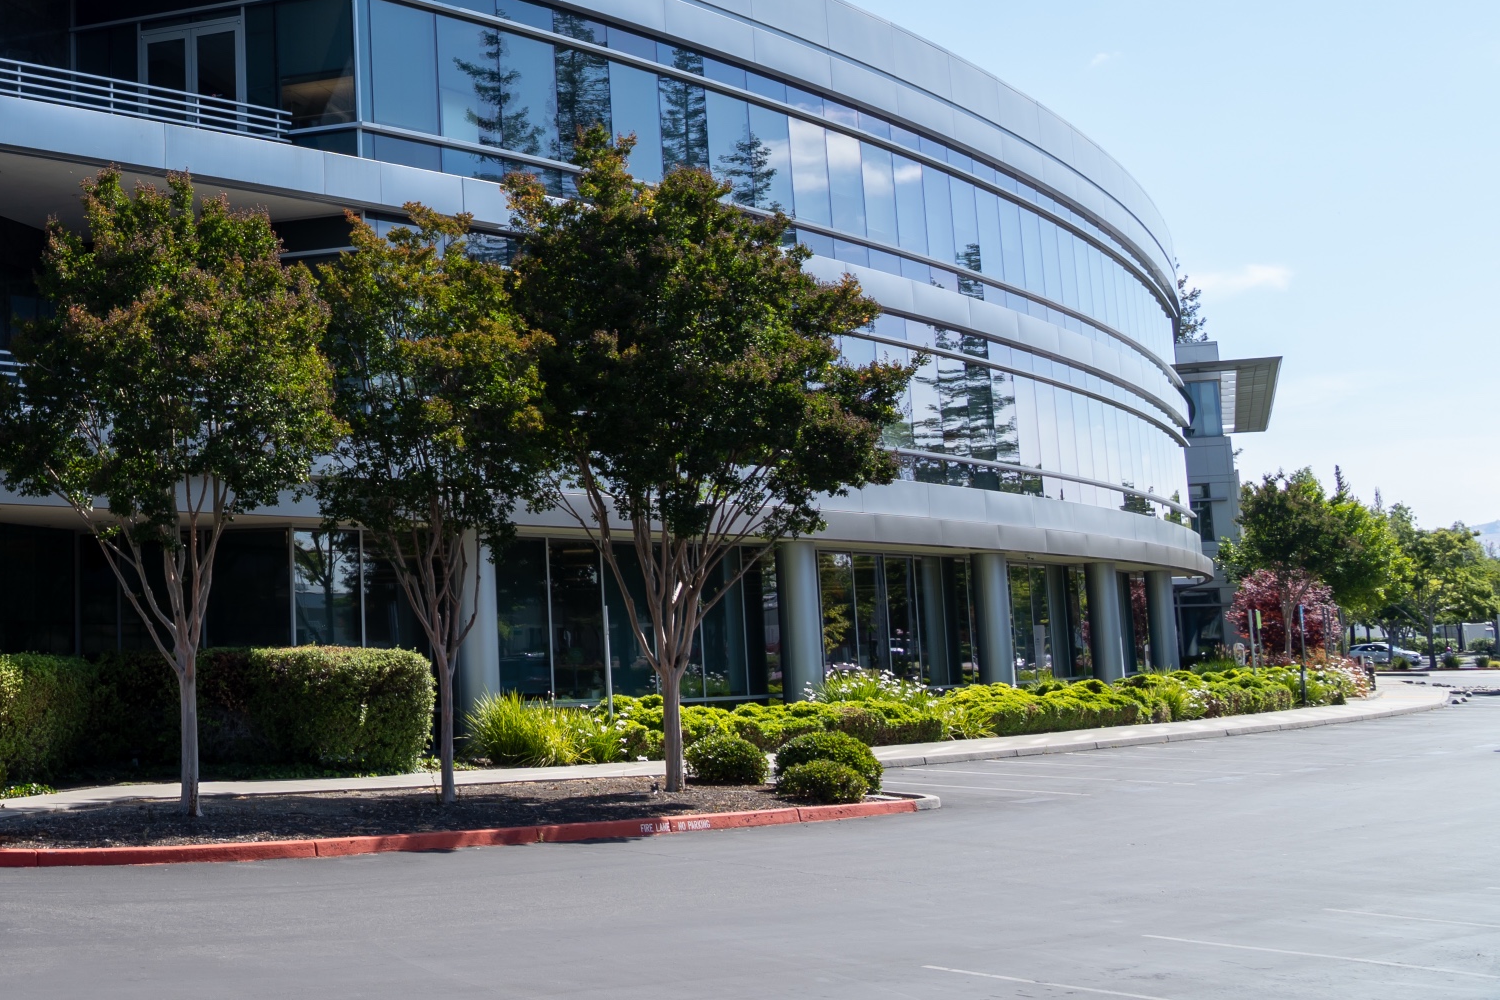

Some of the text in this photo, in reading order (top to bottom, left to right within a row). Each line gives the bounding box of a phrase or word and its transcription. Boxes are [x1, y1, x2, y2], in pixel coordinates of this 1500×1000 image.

[640, 823, 654, 833] FIRE
[655, 822, 671, 832] LANE
[677, 821, 687, 831] NO
[687, 819, 711, 830] PARKING
